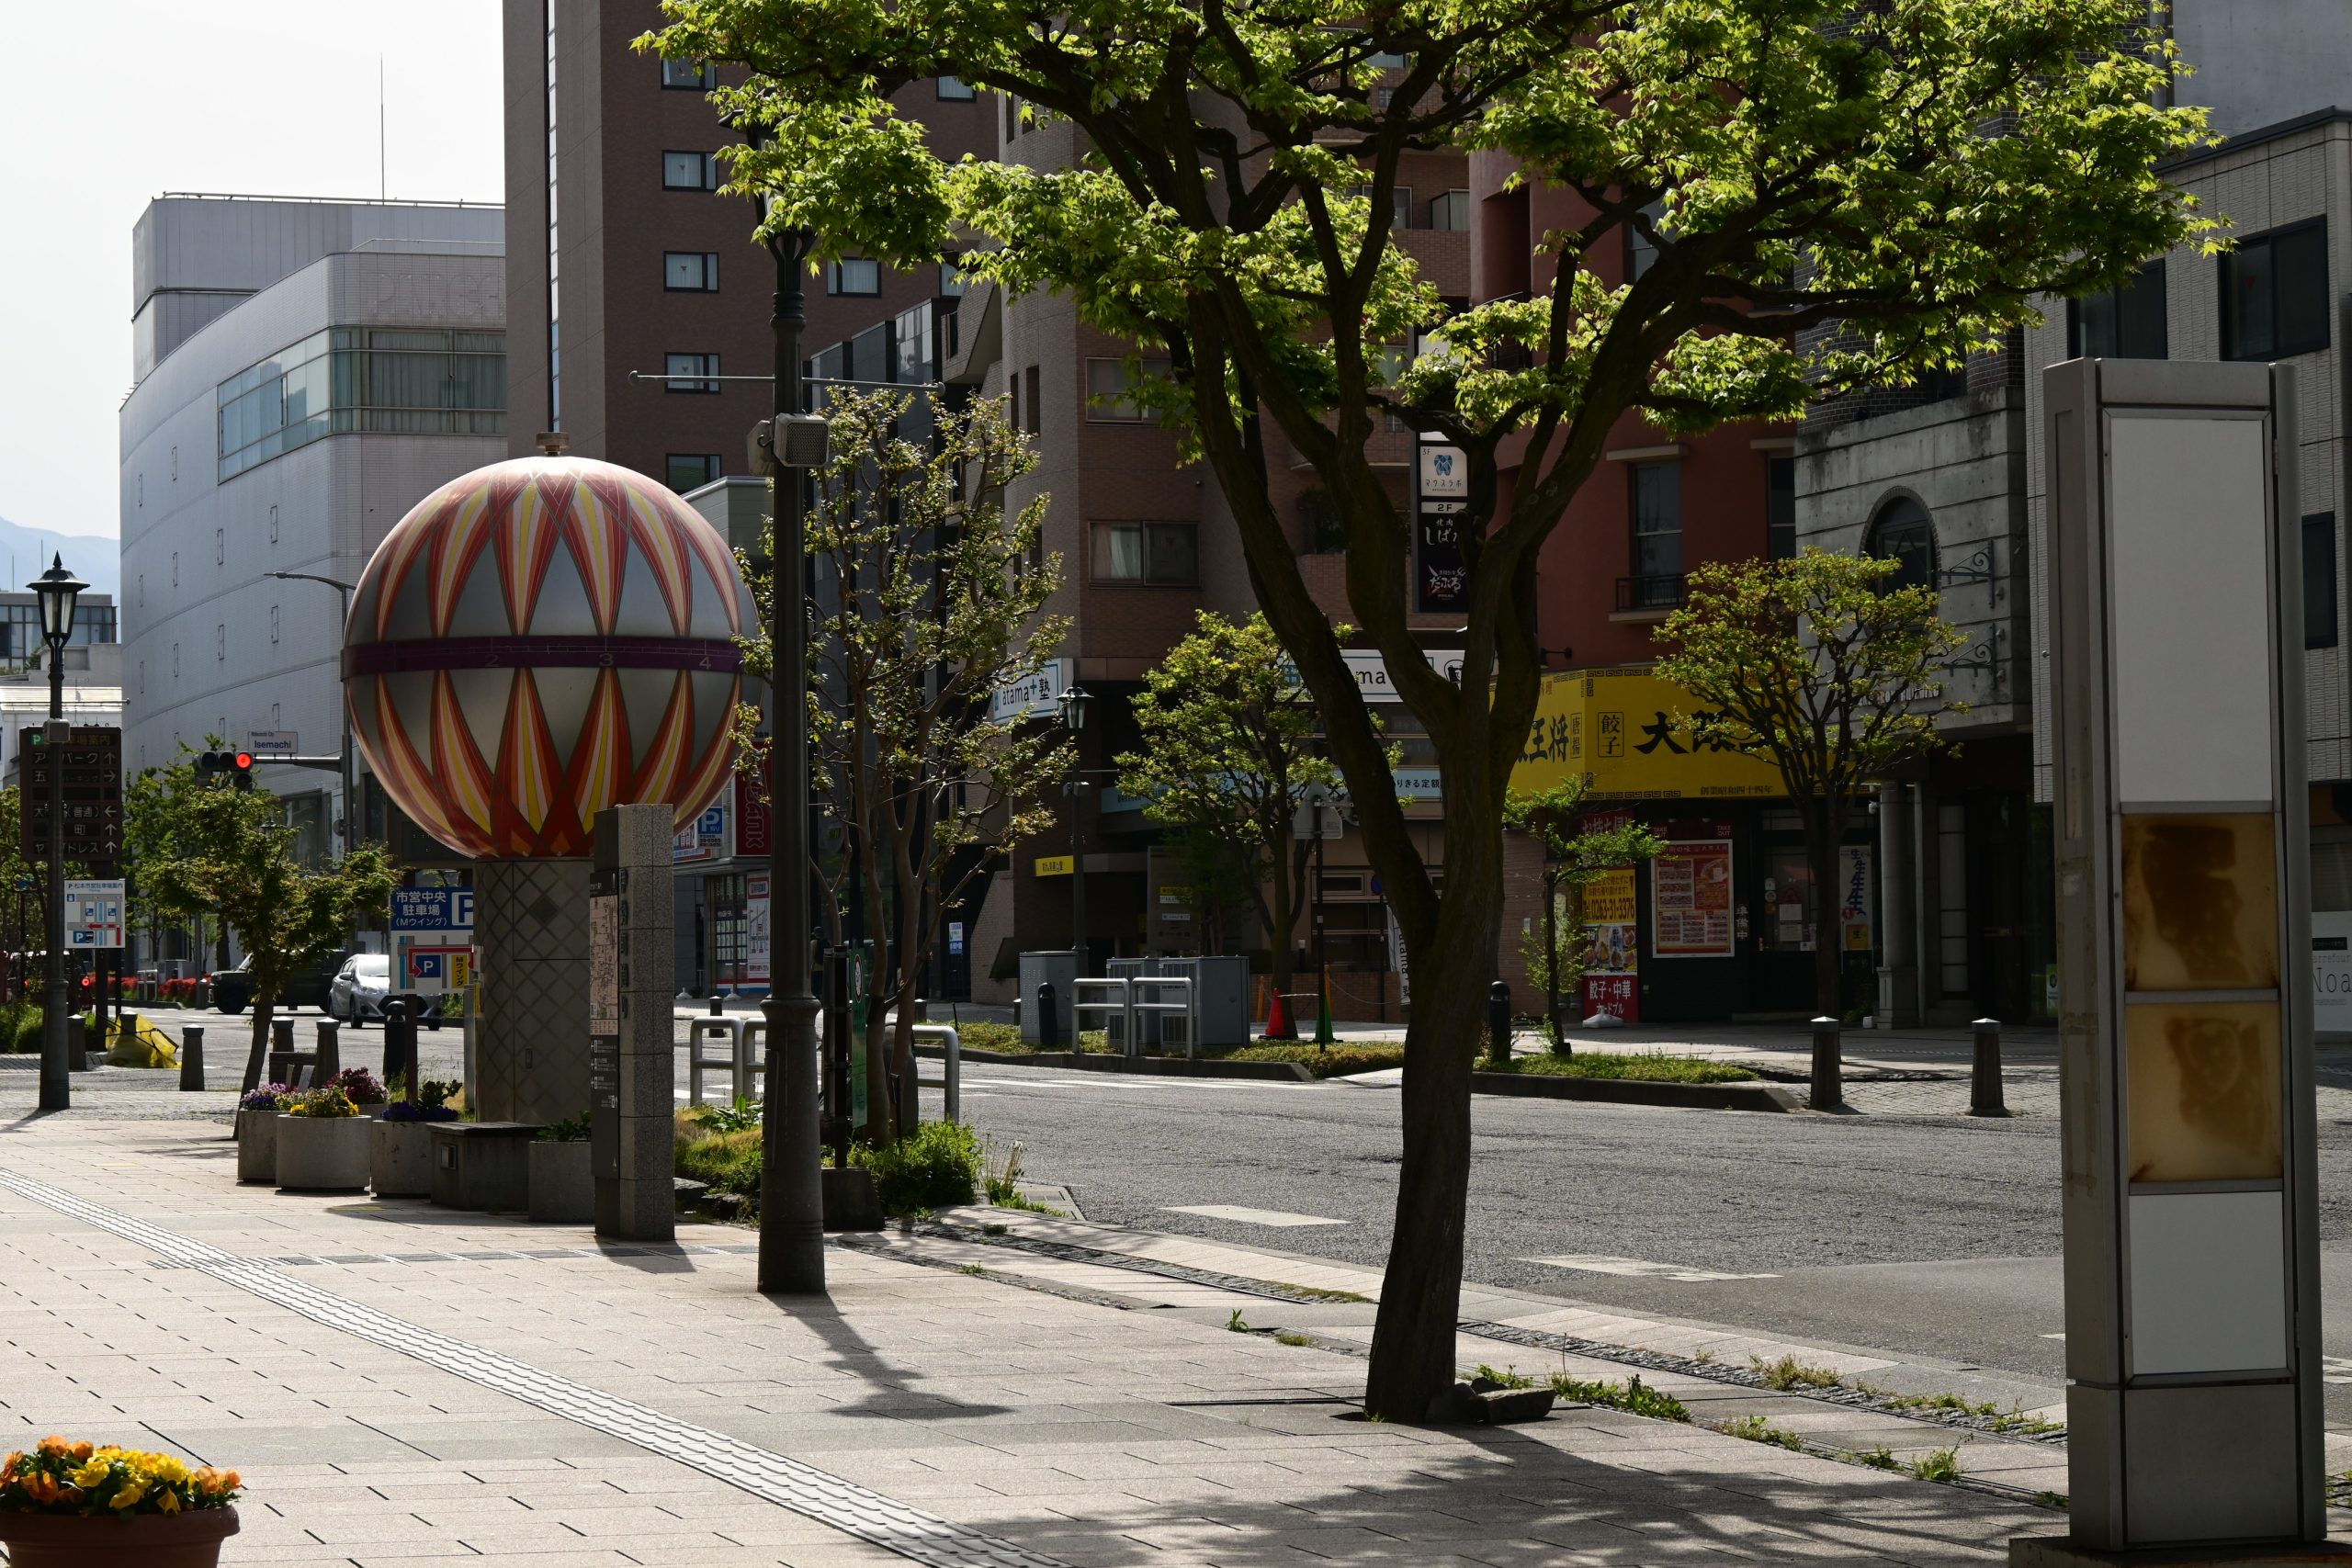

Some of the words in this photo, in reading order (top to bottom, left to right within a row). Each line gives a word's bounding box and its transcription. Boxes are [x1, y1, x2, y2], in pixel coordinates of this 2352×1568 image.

[486, 655, 500, 668] 2
[600, 654, 615, 667] 3
[699, 656, 713, 669] 4
[33, 734, 41, 745] P
[1601, 714, 1621, 755] 餃子
[254, 740, 291, 749] Isemachi
[701, 810, 720, 832] P
[396, 891, 447, 903] 市営中央
[402, 904, 440, 916] 駐車場
[75, 933, 84, 942] P
[424, 961, 434, 974] P
